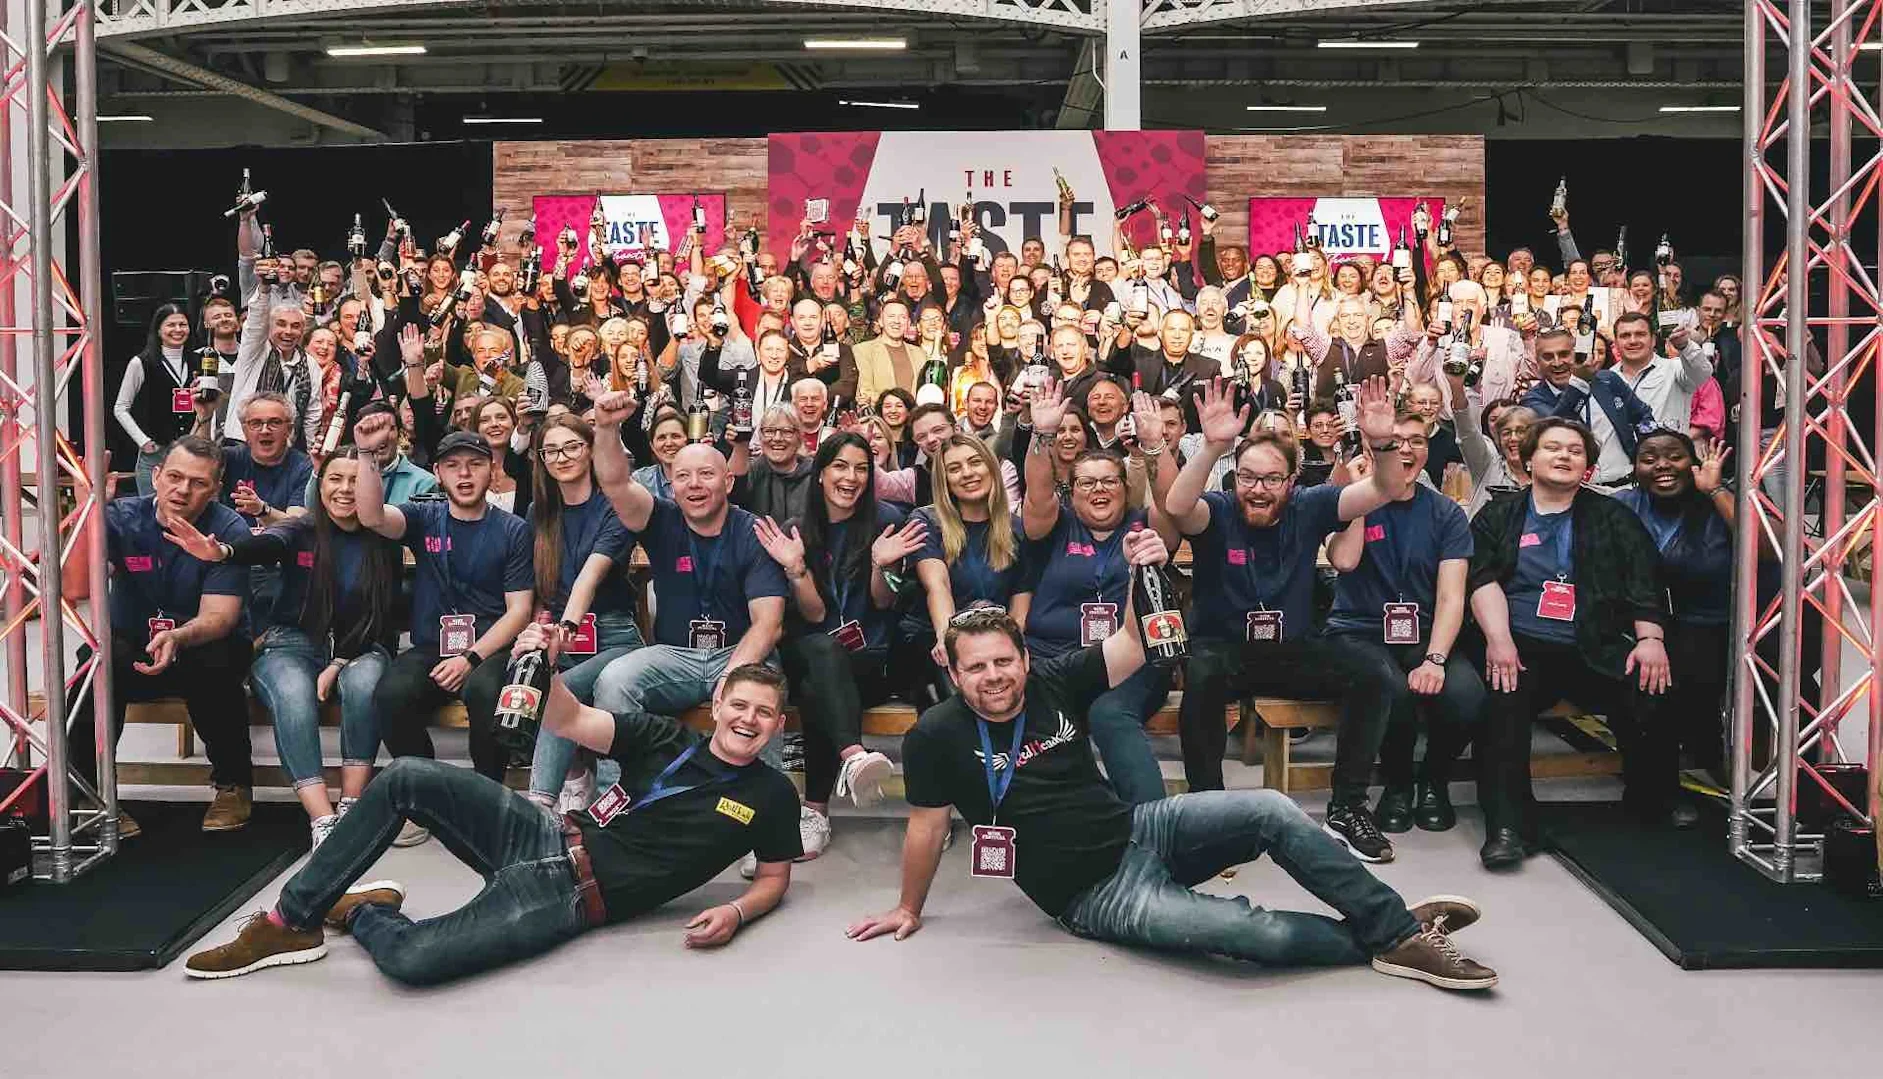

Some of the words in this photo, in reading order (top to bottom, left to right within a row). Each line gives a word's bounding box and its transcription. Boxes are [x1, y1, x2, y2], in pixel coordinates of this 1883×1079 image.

[1120, 50, 1128, 59] A
[964, 170, 1013, 187] THE
[1318, 224, 1380, 248] TASTE
